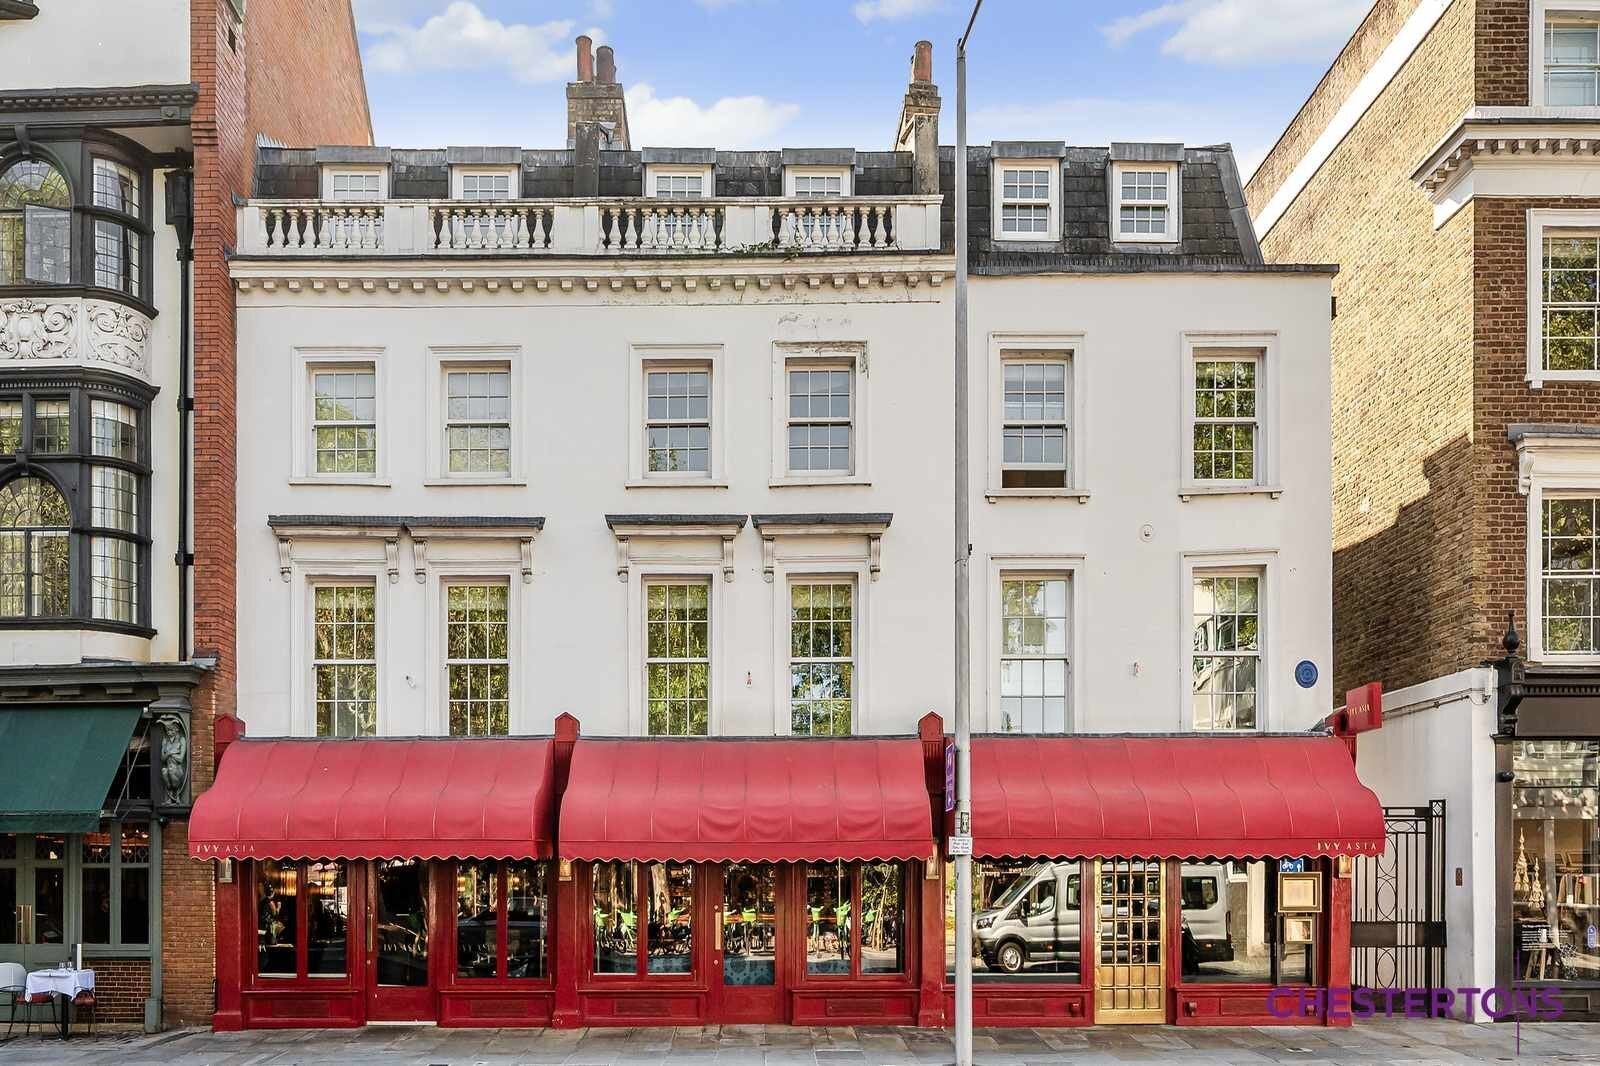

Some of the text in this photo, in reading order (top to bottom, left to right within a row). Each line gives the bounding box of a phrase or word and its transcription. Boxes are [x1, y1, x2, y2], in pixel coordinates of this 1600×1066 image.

[196, 844, 255, 853] IVY ASIA
[1317, 842, 1377, 851] IVY ASIA
